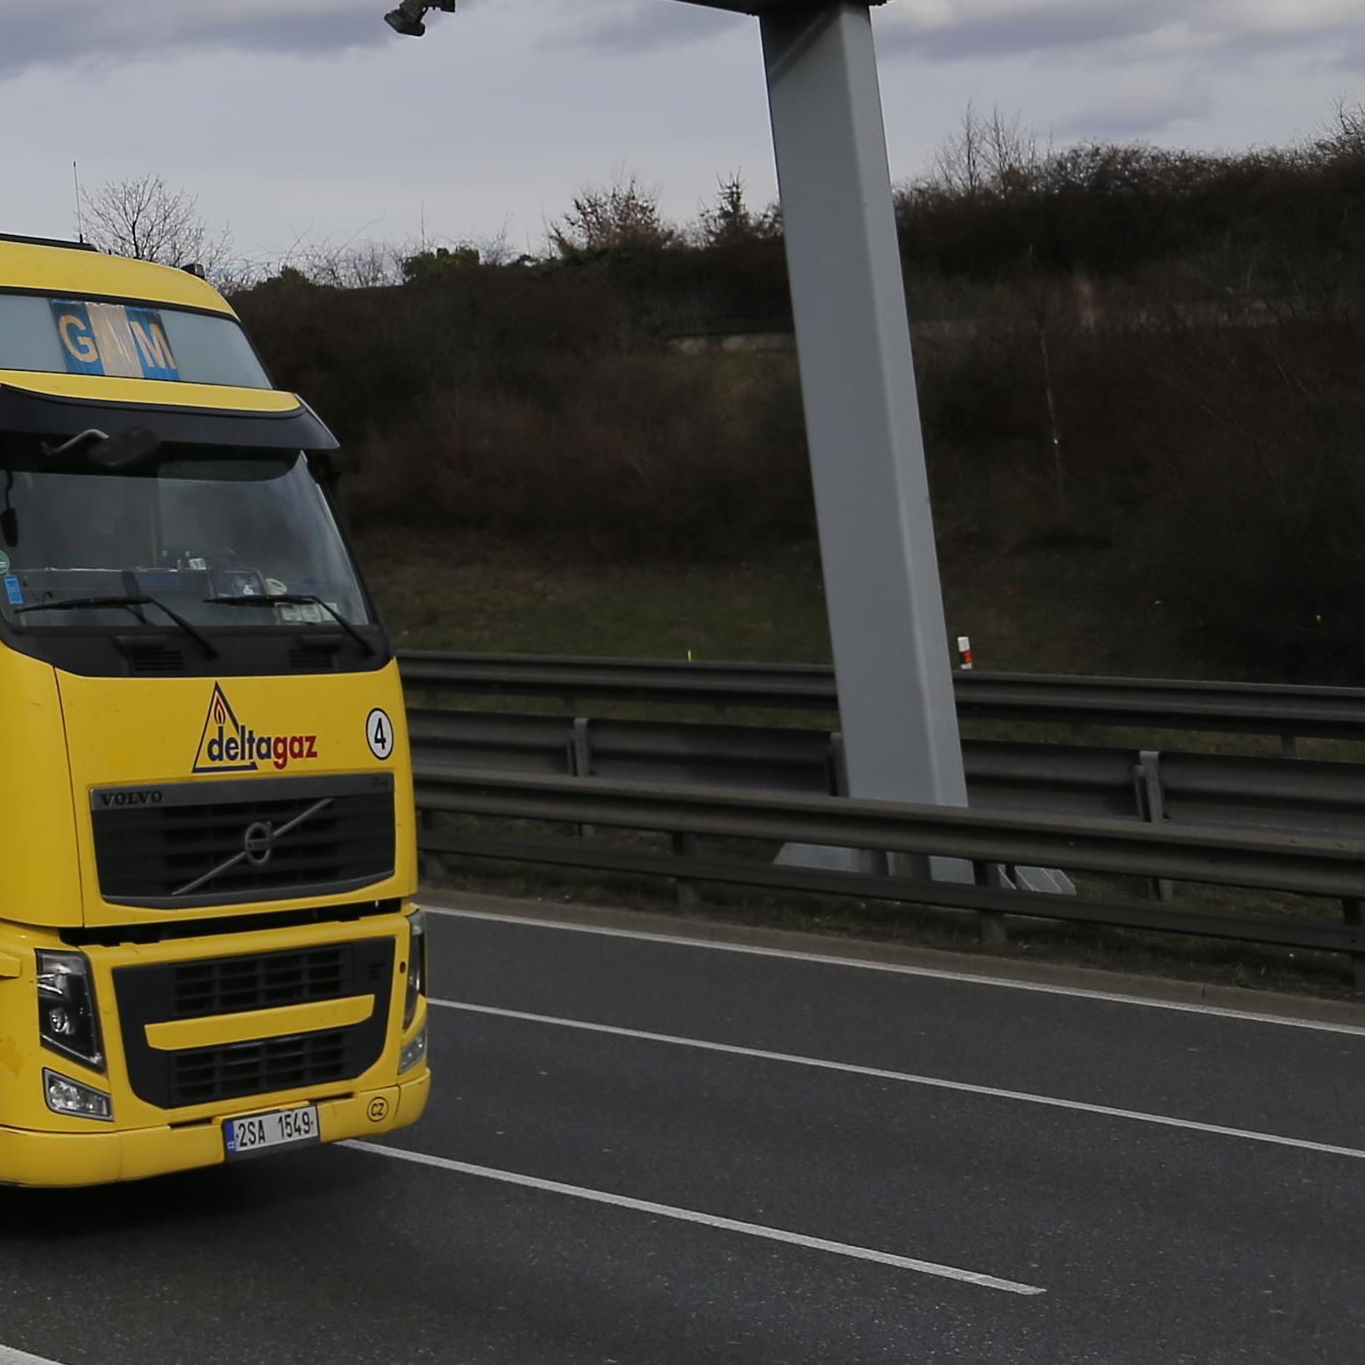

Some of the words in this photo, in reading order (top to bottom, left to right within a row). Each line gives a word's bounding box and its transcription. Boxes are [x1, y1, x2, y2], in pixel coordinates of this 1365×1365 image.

[207, 725, 318, 770] deltagaz
[374, 717, 386, 750] 4
[99, 790, 163, 806] VOLVO
[370, 1102, 385, 1117] CZ
[238, 1119, 266, 1148] 2SA
[277, 1111, 311, 1140] 1549
